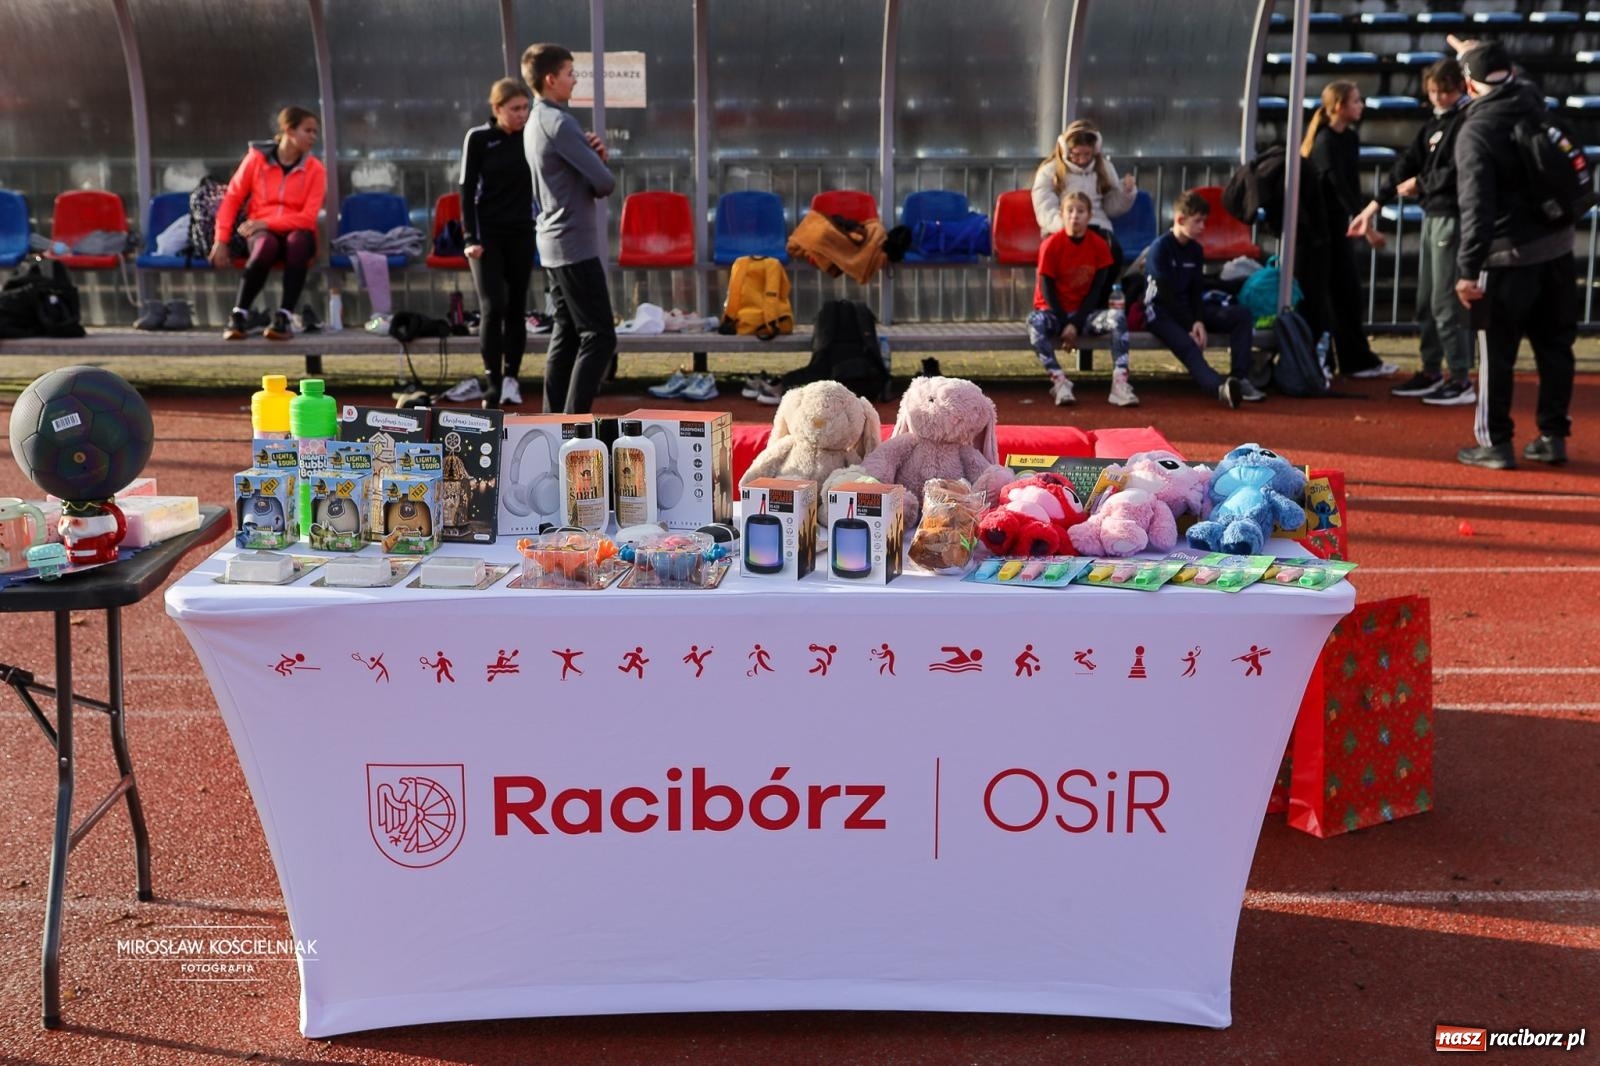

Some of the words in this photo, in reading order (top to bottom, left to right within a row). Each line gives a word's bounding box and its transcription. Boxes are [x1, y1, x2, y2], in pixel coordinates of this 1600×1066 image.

[299, 459, 328, 469] Bubbl
[338, 481, 352, 495] TEST
[411, 484, 425, 498] TEST
[493, 766, 887, 836] Racibórz
[983, 768, 1170, 833] OSiR
